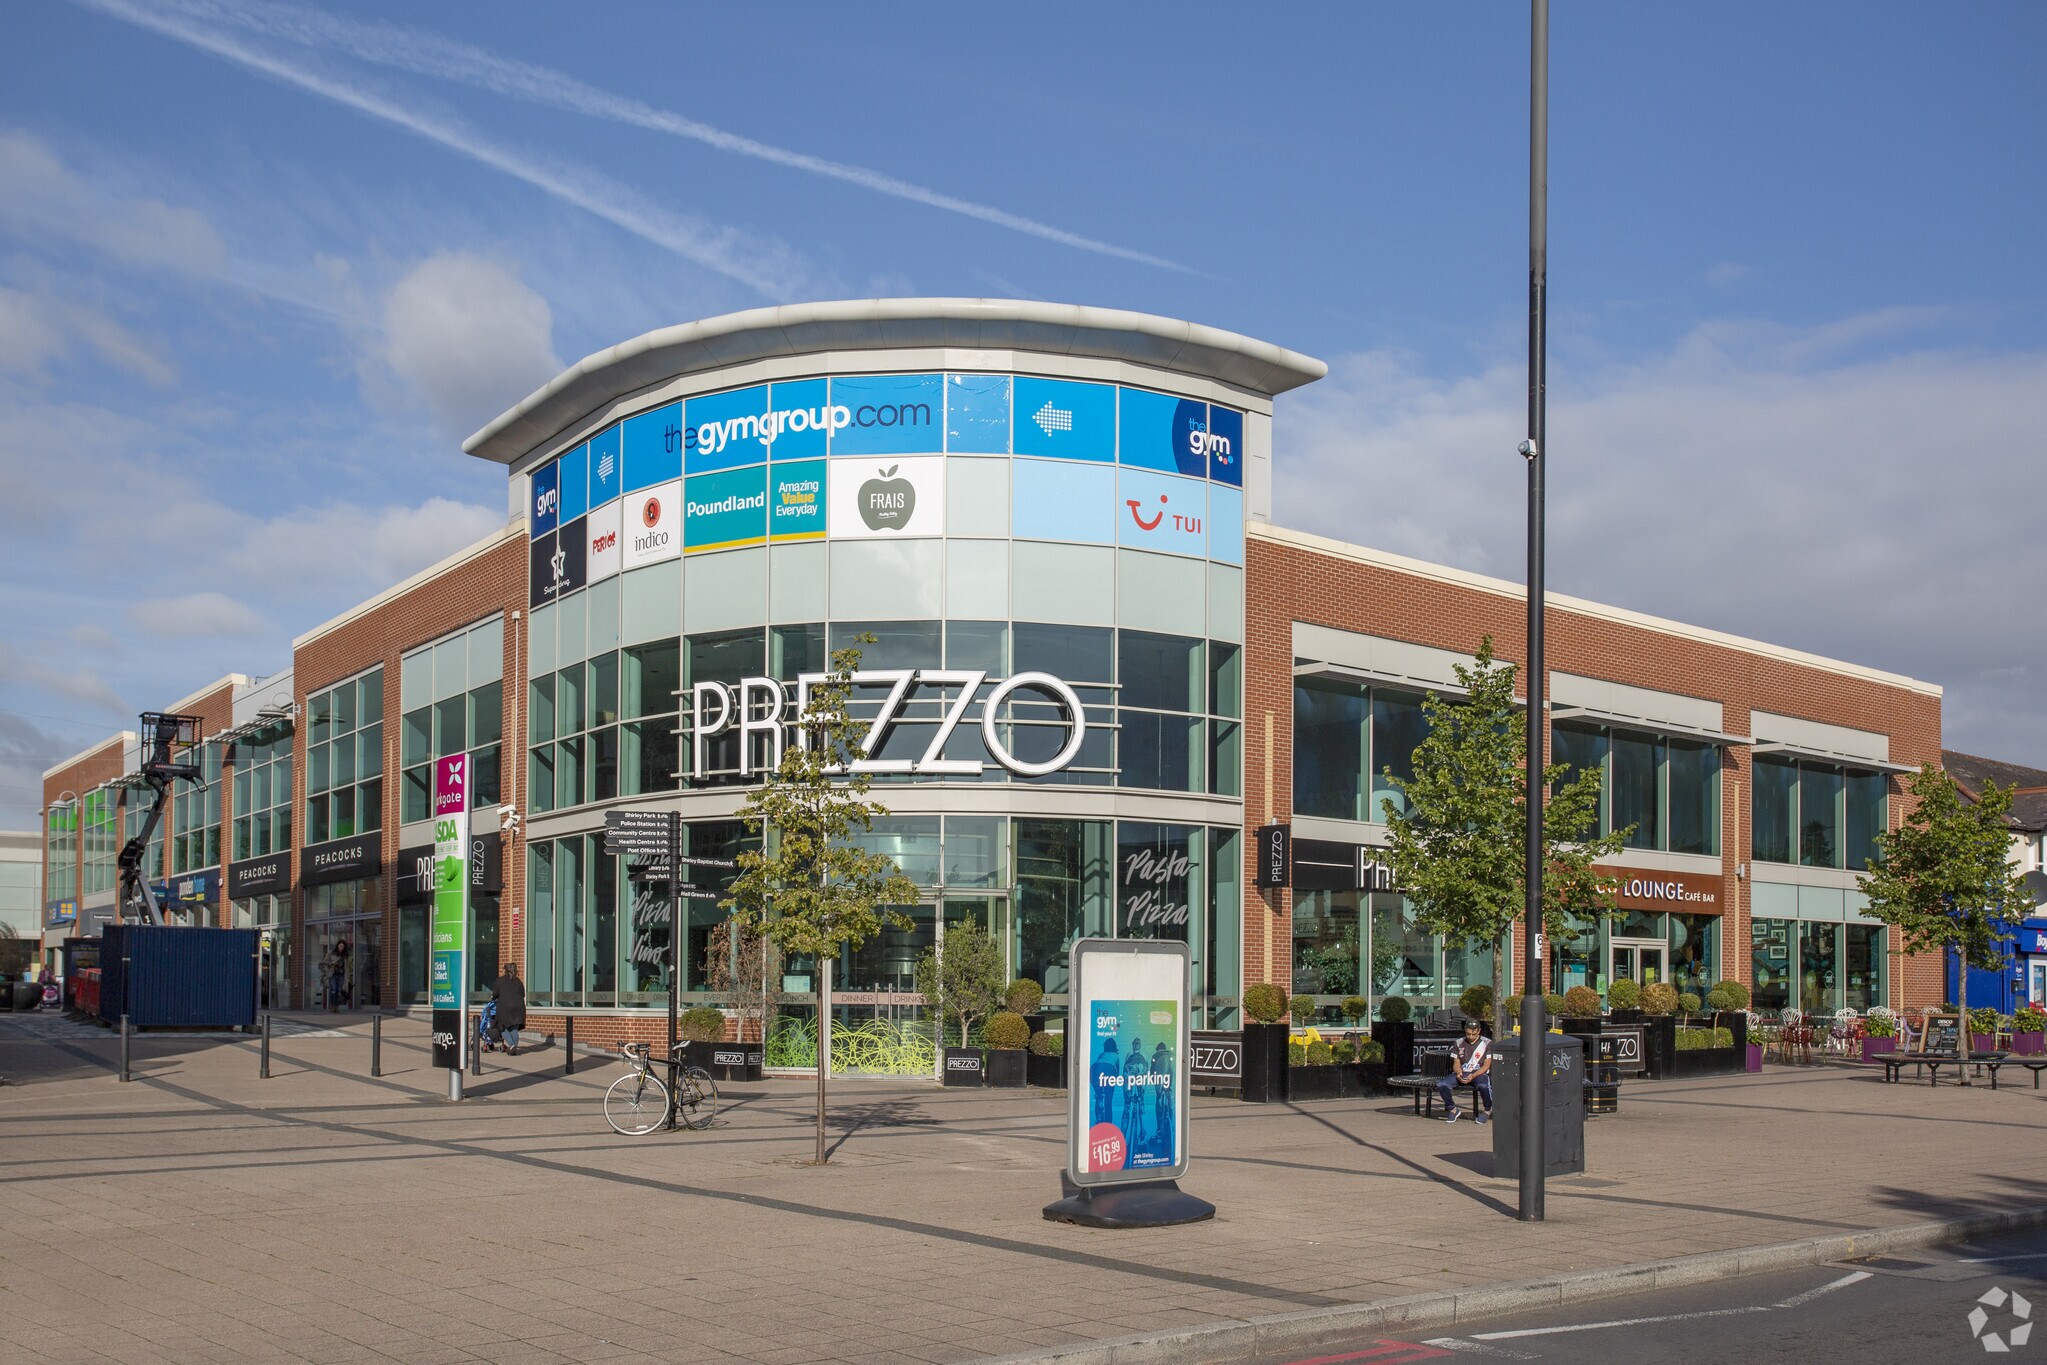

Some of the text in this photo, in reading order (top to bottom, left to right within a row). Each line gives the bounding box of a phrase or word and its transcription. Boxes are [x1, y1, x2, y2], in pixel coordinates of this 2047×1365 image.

[664, 403, 931, 455] thegymgroup.com
[1189, 417, 1206, 432] the
[1189, 430, 1231, 456] gym
[778, 480, 819, 493] Amazing
[537, 488, 556, 517] gym
[687, 491, 765, 517] Poundland
[782, 491, 815, 505] Value
[870, 493, 904, 509] FRAIS
[776, 503, 818, 517] Everyday
[1172, 514, 1201, 534] TUI
[634, 531, 669, 551] indico
[543, 577, 571, 595] Supedrug
[693, 669, 1086, 778] PREZZO
[625, 812, 643, 820] Shirley
[315, 847, 362, 866] PEACOCKS
[472, 840, 485, 885] PREZZO
[697, 858, 714, 866] Baptist
[1272, 830, 1283, 882] PREZZO
[239, 863, 277, 880] PEACOCKS
[1125, 849, 1189, 885] Pasta
[1624, 879, 1684, 900] LOUNGE
[1685, 891, 1701, 901] CAFÉ
[1702, 893, 1715, 903] BAR
[1126, 890, 1189, 928] Pizza
[841, 994, 874, 1002] DINNER
[1096, 1008, 1108, 1016] the
[1096, 1016, 1117, 1028] gym
[716, 1054, 742, 1063] PREZZO
[949, 1060, 978, 1068] PREZZO
[1191, 1048, 1238, 1071] REZZO
[1098, 1071, 1171, 1090] free parking
[1093, 1140, 1121, 1166] £16.99
